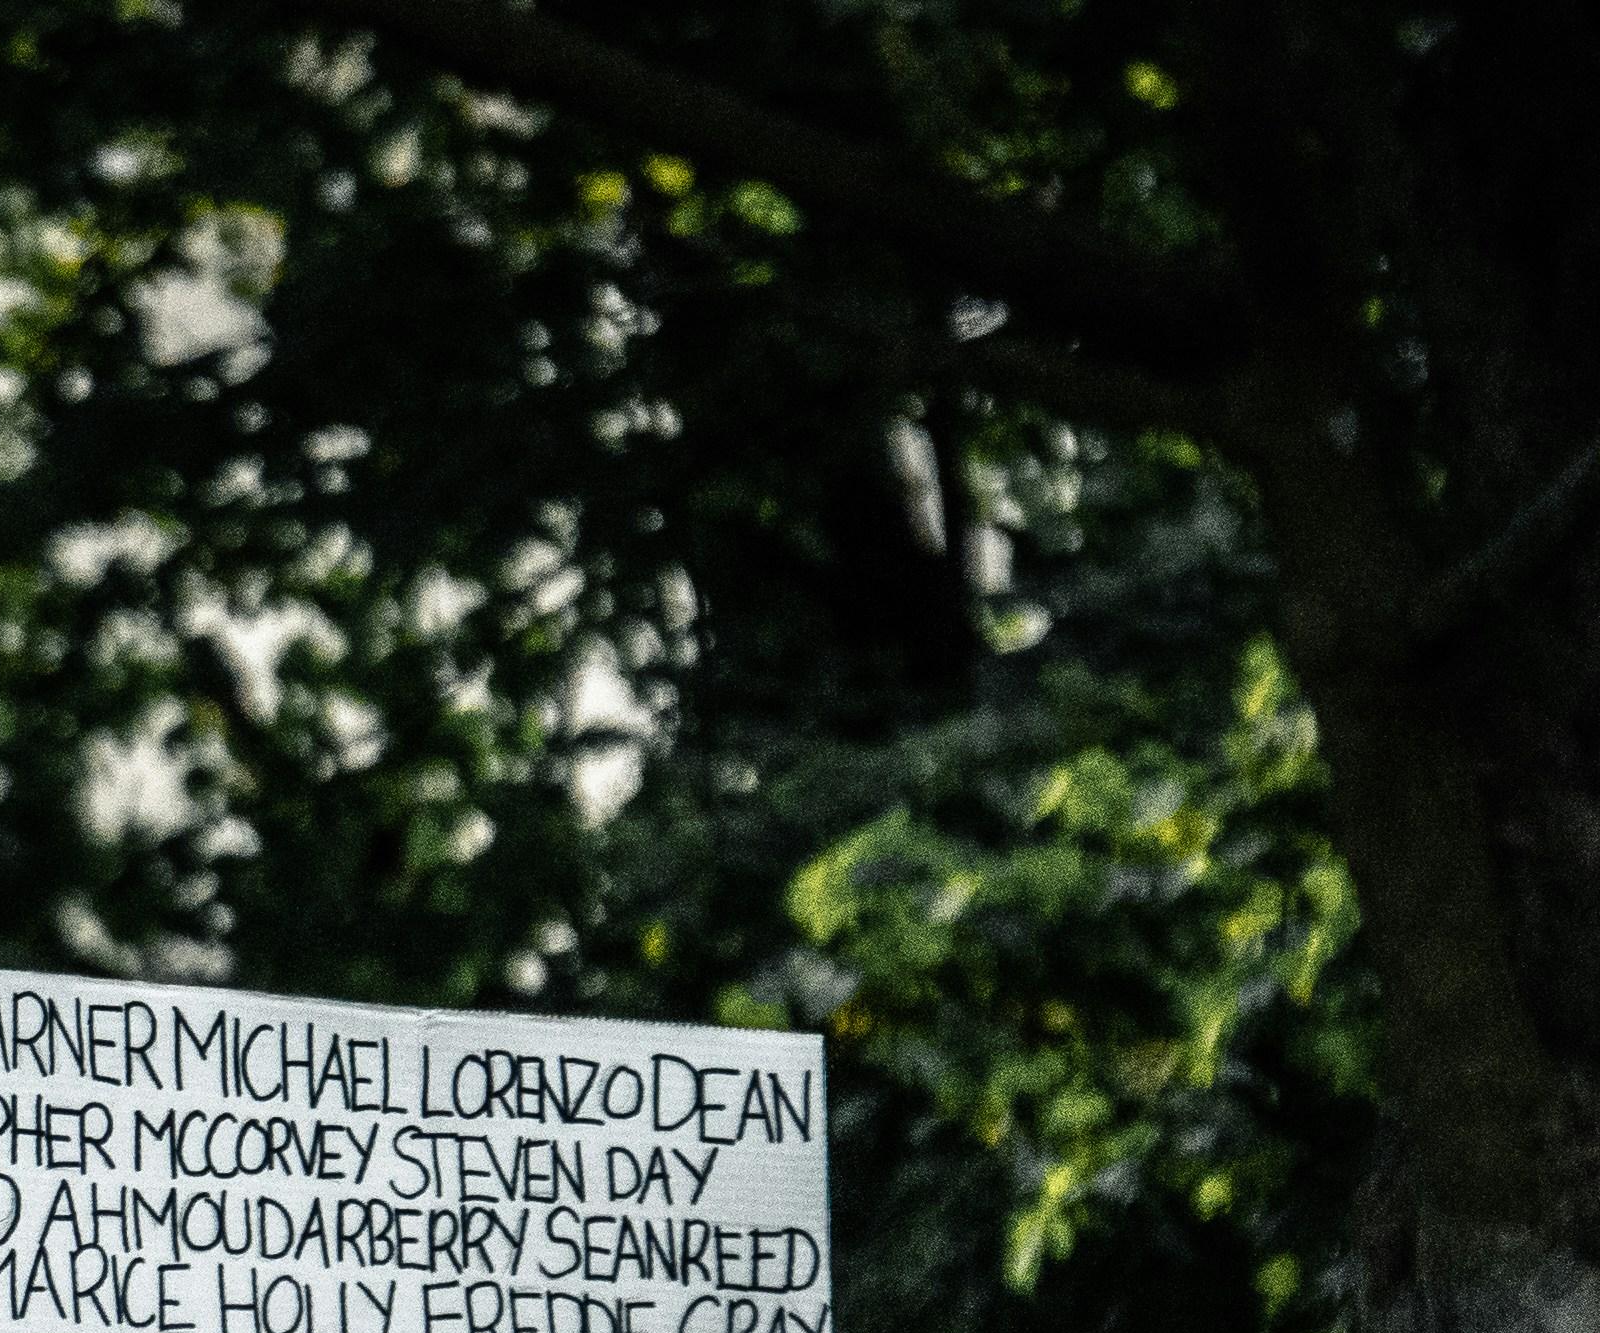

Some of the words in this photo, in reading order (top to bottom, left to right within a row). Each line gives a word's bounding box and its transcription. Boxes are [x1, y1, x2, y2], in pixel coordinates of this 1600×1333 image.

[172, 1005, 407, 1115] MICHAEL
[423, 1046, 644, 1125] LORENZO
[652, 1054, 812, 1145] DEAN
[134, 1104, 381, 1184] MCCORVEY
[390, 1124, 585, 1204] STEVEN
[606, 1145, 719, 1205] DAY
